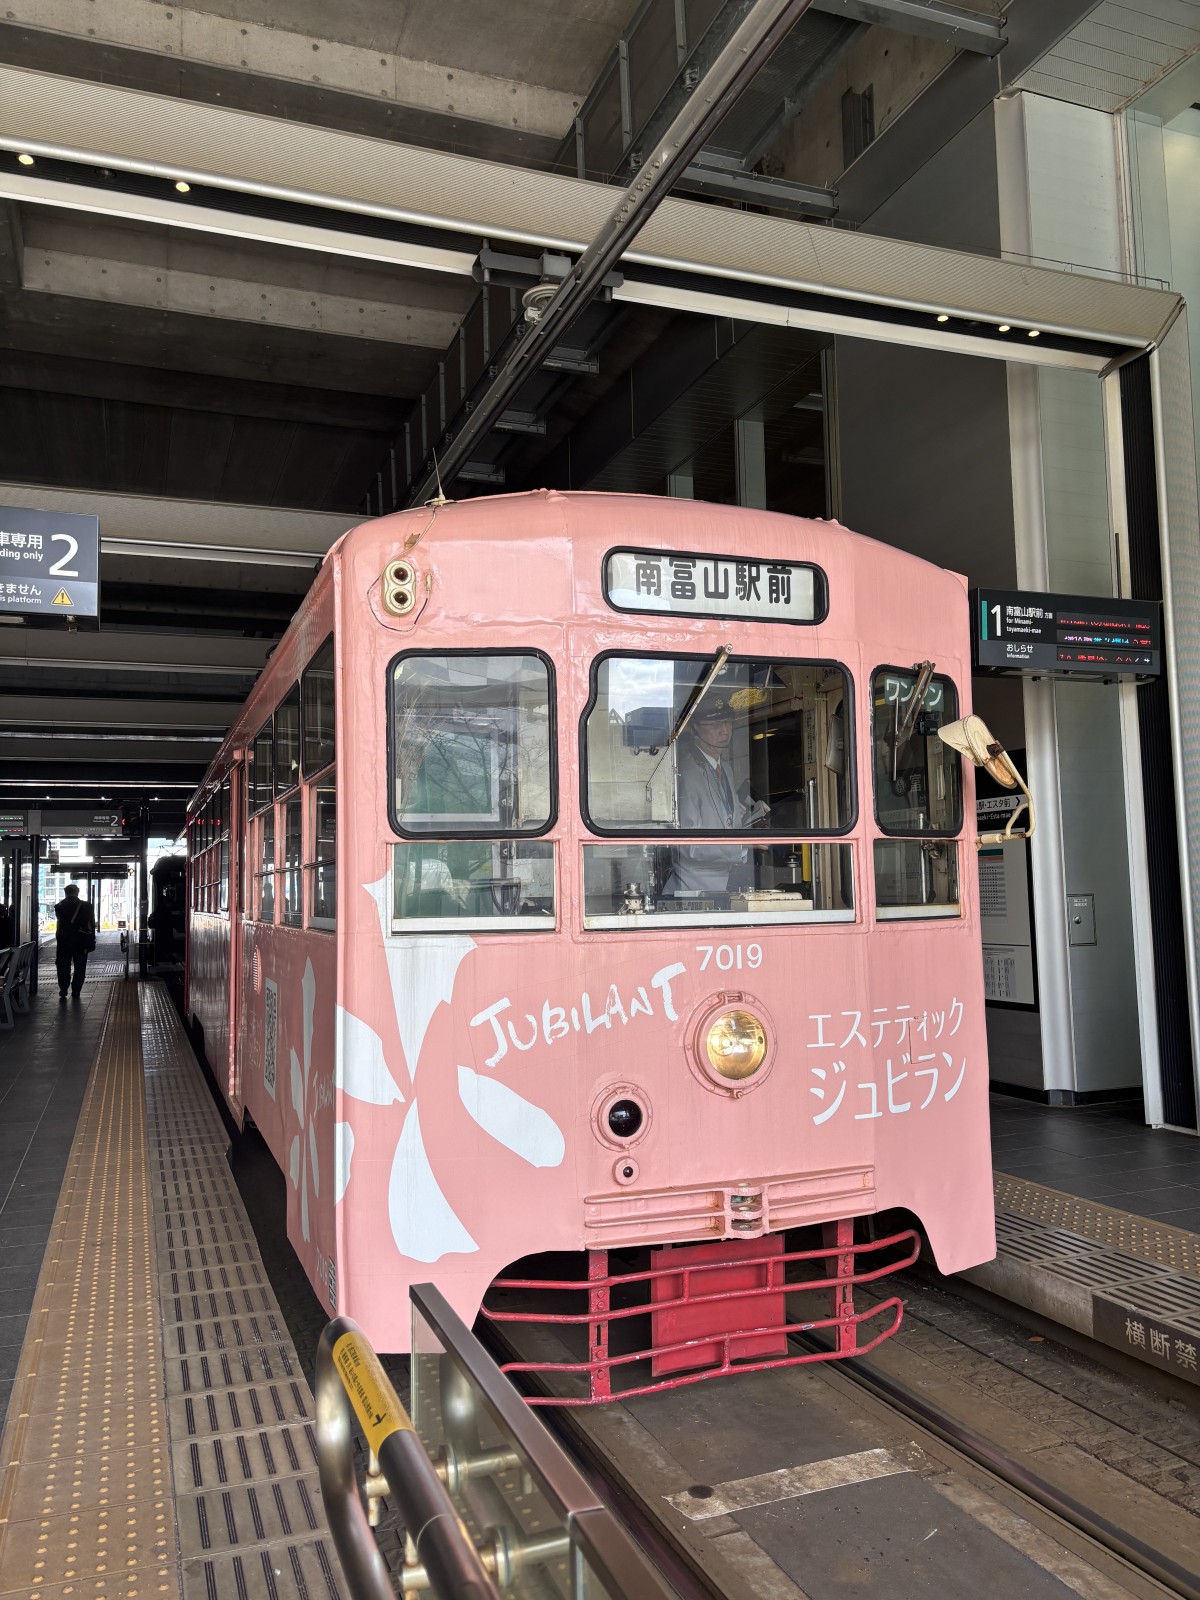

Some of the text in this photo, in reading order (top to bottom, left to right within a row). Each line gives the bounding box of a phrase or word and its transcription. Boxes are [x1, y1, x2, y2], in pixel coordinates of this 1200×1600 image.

[0, 549, 44, 562] ding only
[49, 533, 79, 577] 2
[634, 554, 792, 604] 南富山駅前
[7, 595, 42, 604] platform
[990, 604, 1002, 637] 1
[1006, 643, 1034, 653] おしらせ
[110, 815, 119, 827] 2
[696, 943, 763, 971] 7019
[470, 961, 687, 1068] JUBILANT
[806, 996, 964, 1048] エステティック
[811, 1051, 966, 1125] ジュビラン
[1125, 1317, 1198, 1372] 横断禁
